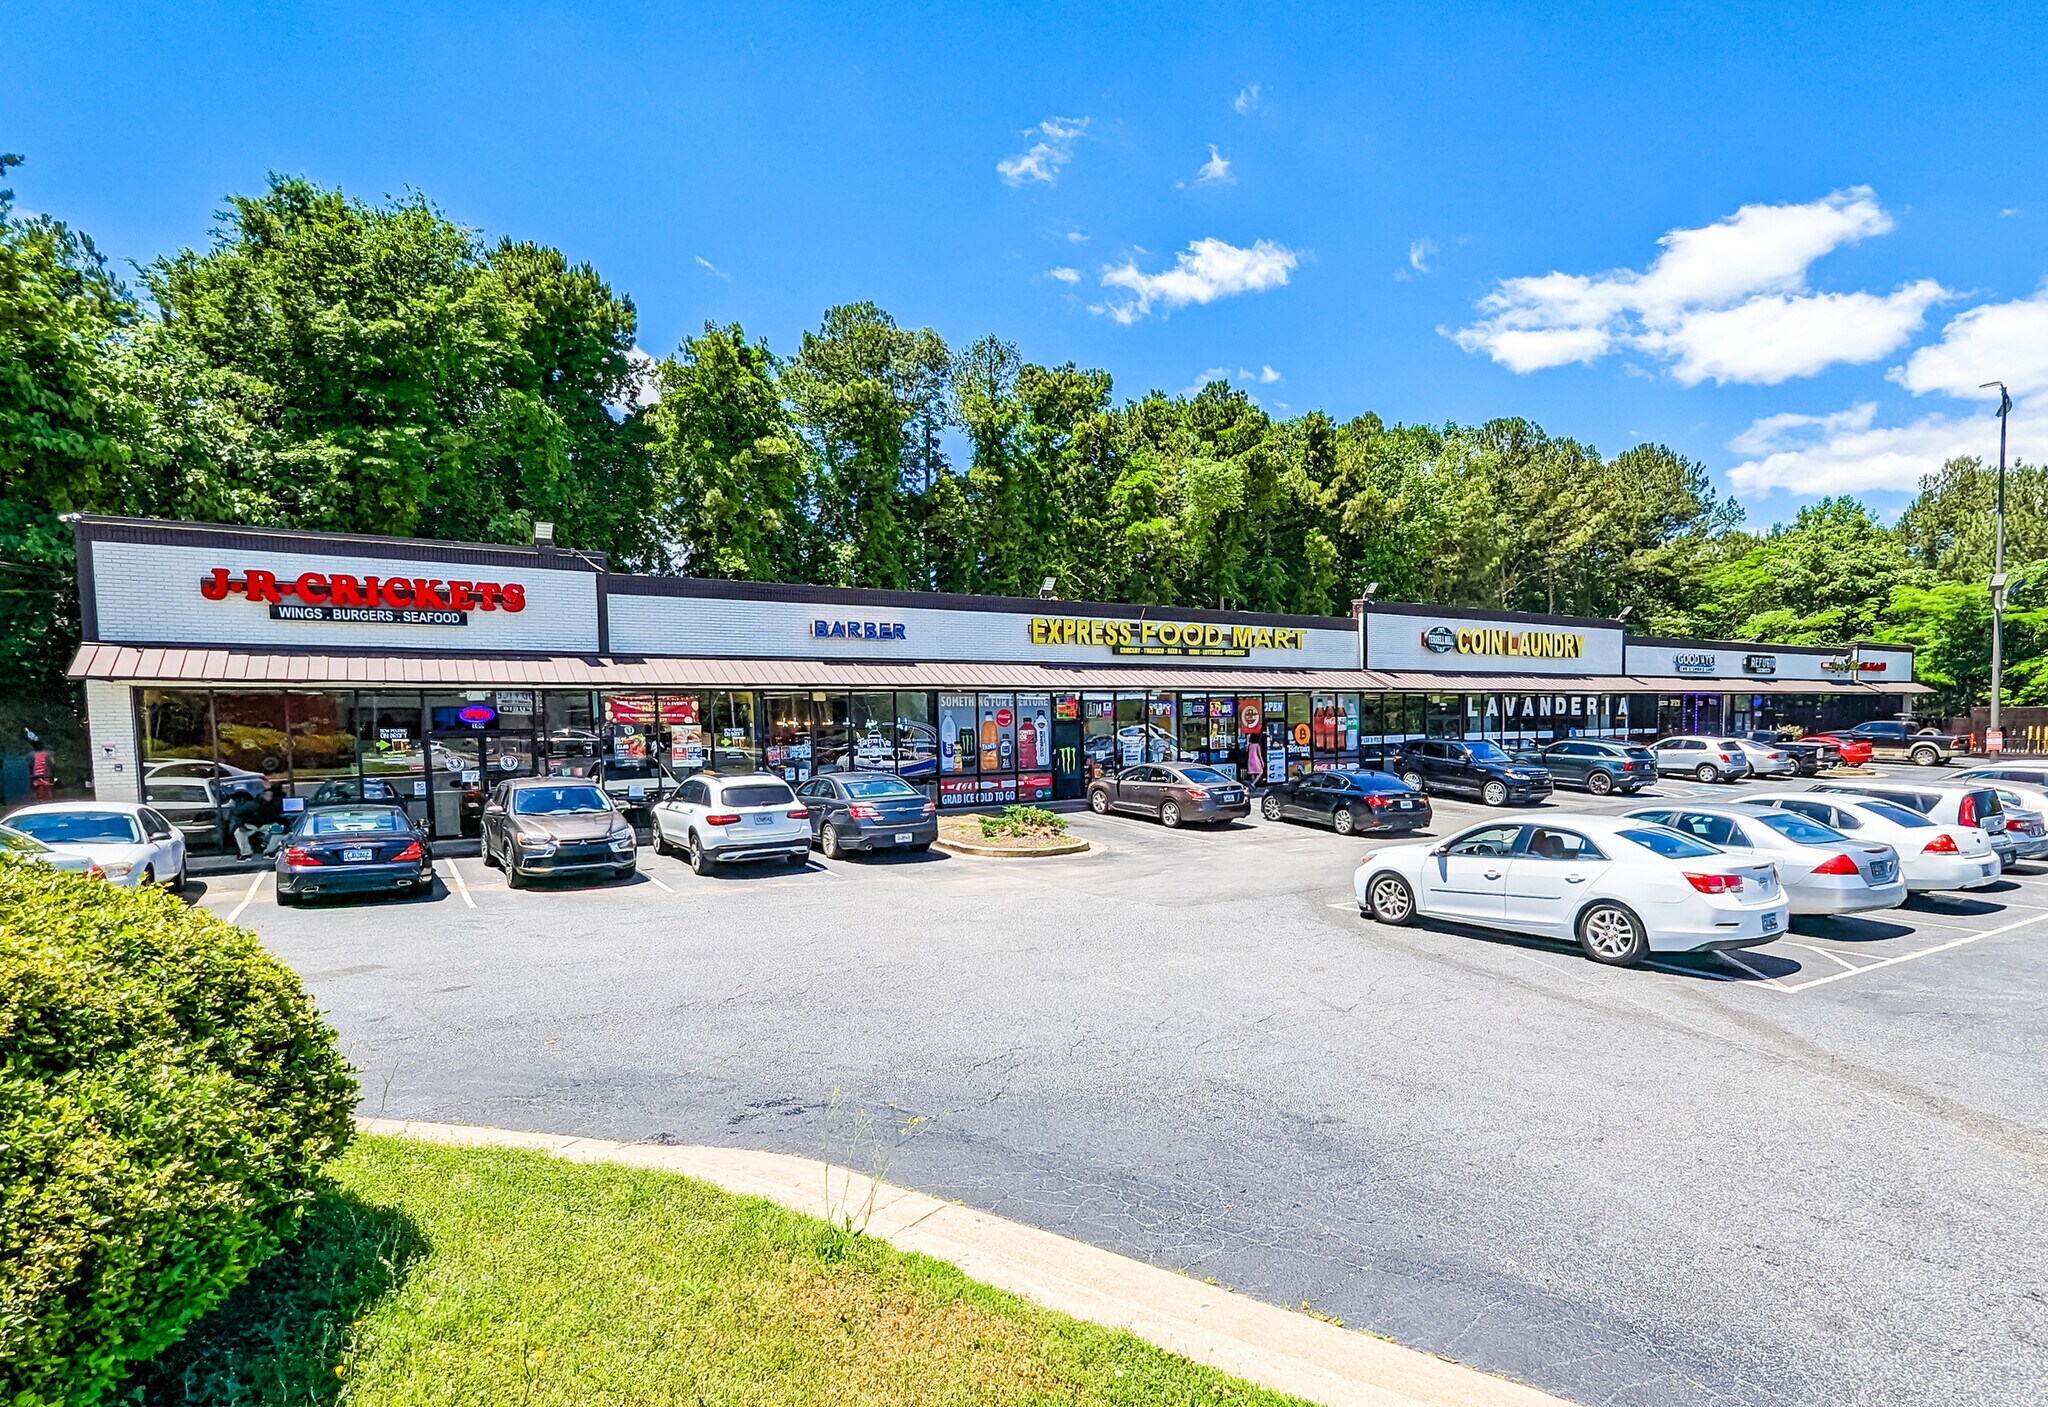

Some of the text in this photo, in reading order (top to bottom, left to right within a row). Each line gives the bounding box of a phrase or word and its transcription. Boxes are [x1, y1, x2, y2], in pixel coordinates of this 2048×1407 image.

[279, 607, 460, 624] WINGS BURGERS SEAFOOD
[812, 619, 906, 640] BARBER
[1031, 618, 1307, 651] EXPRESS FOOD MART
[1456, 627, 1585, 658] COIN LAUNDRY
[941, 695, 989, 707] SOMETHNG
[1264, 702, 1283, 712] OPEN
[1467, 696, 1629, 717] LAVANDERIA
[1288, 744, 1310, 754] Bitcoin
[941, 793, 962, 805] GRAB
[963, 793, 974, 804] ICE
[995, 792, 1004, 802] TO
[1005, 791, 1016, 801] GO
